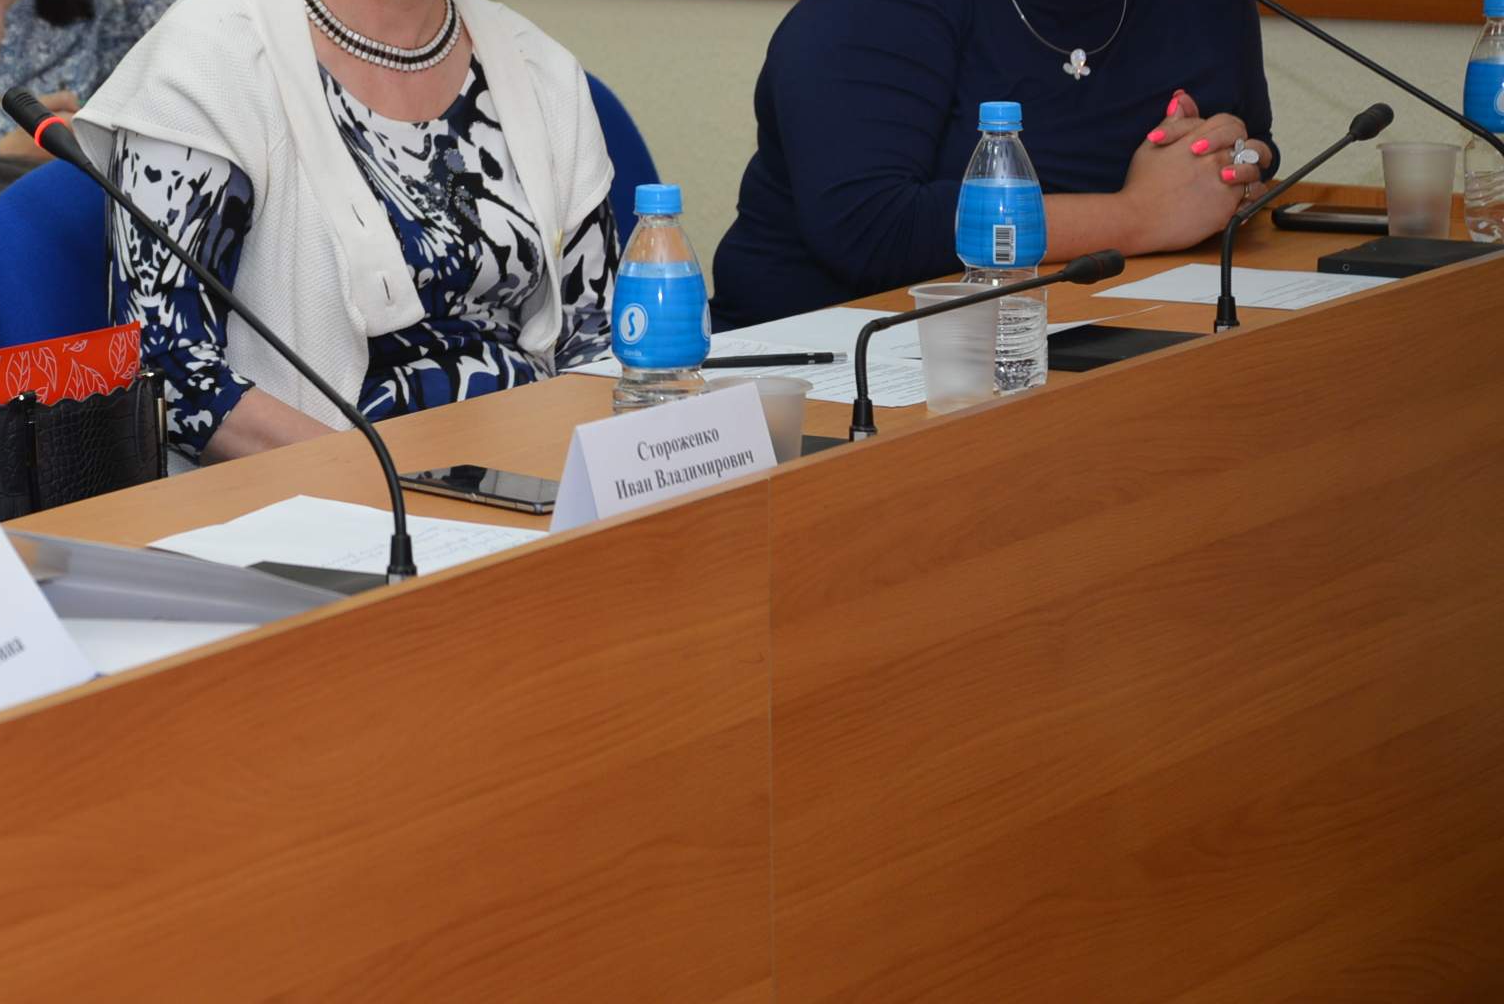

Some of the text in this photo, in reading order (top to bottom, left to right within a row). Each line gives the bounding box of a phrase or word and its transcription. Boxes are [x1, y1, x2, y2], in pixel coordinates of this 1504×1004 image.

[636, 427, 720, 462] Стороженко
[614, 449, 755, 500] Иван Владимирович
